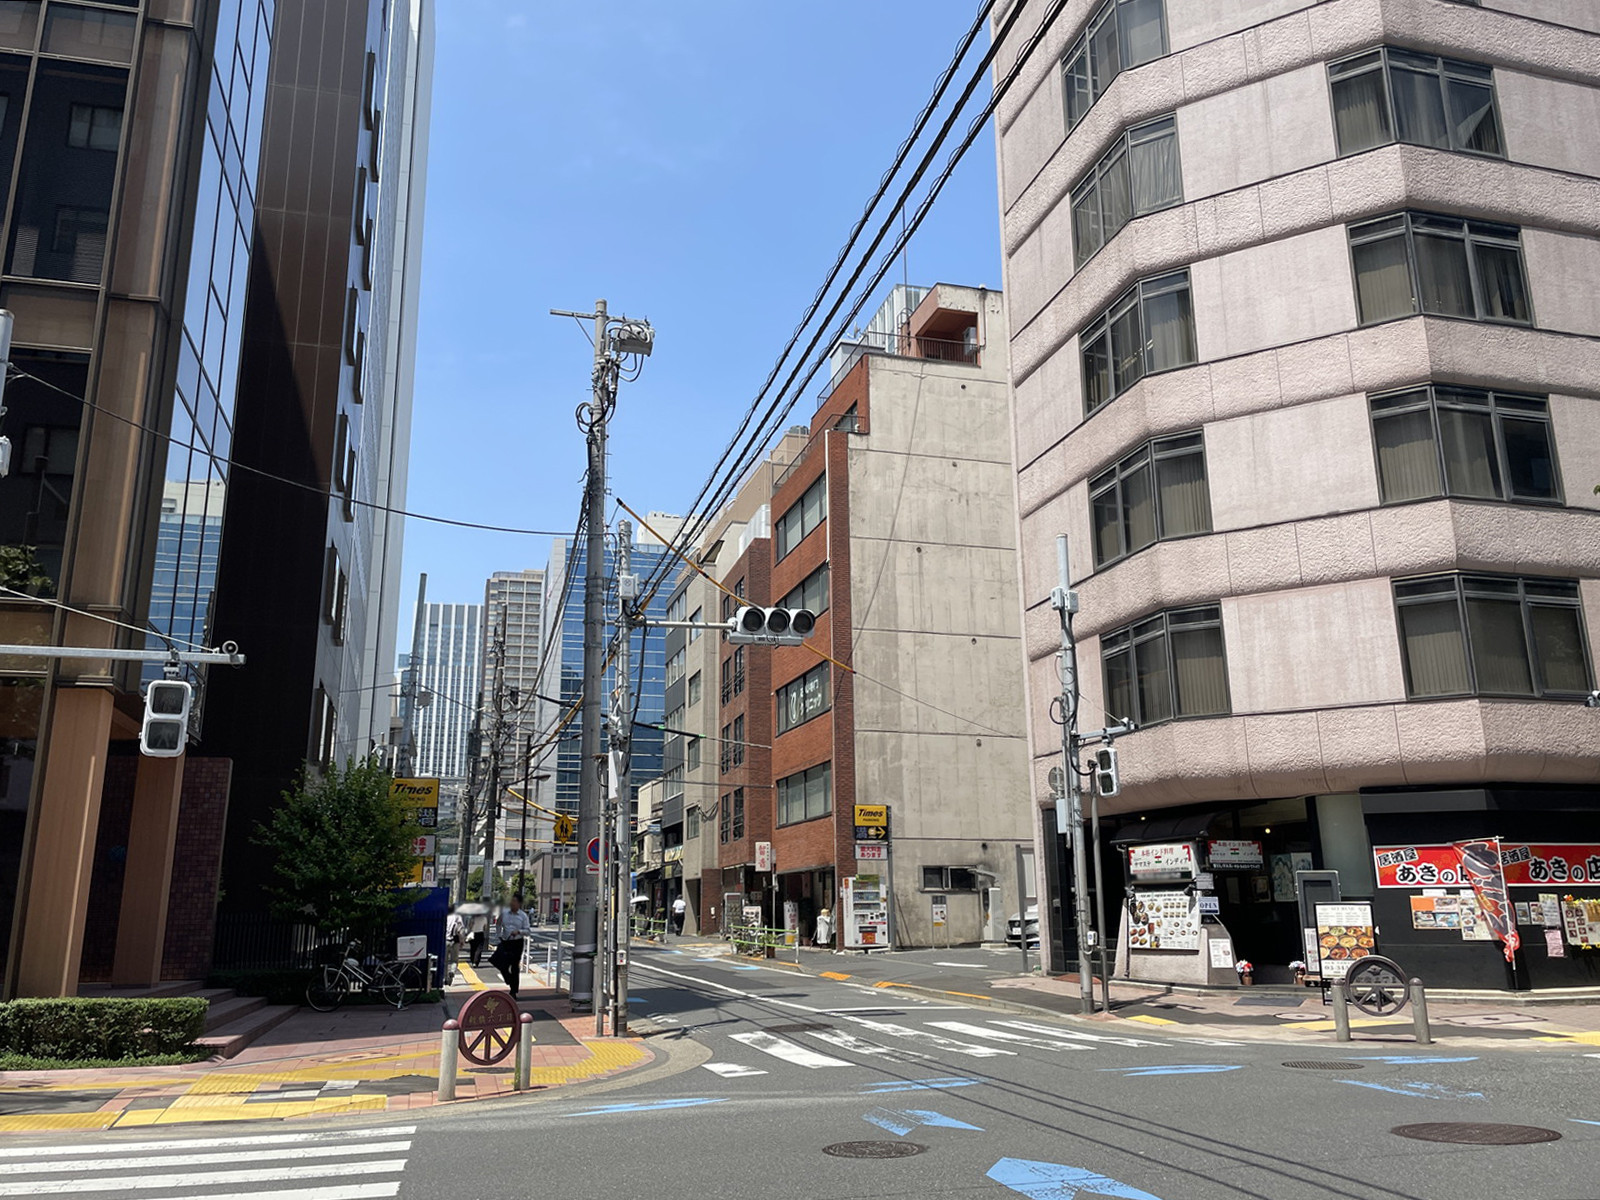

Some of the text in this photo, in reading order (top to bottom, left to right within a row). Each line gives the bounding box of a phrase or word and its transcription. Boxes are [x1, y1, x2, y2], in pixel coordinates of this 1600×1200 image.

[393, 783, 434, 795] Times
[858, 808, 883, 818] Times
[1378, 847, 1418, 867] 居酒屋
[1500, 847, 1532, 866] 居酒屋
